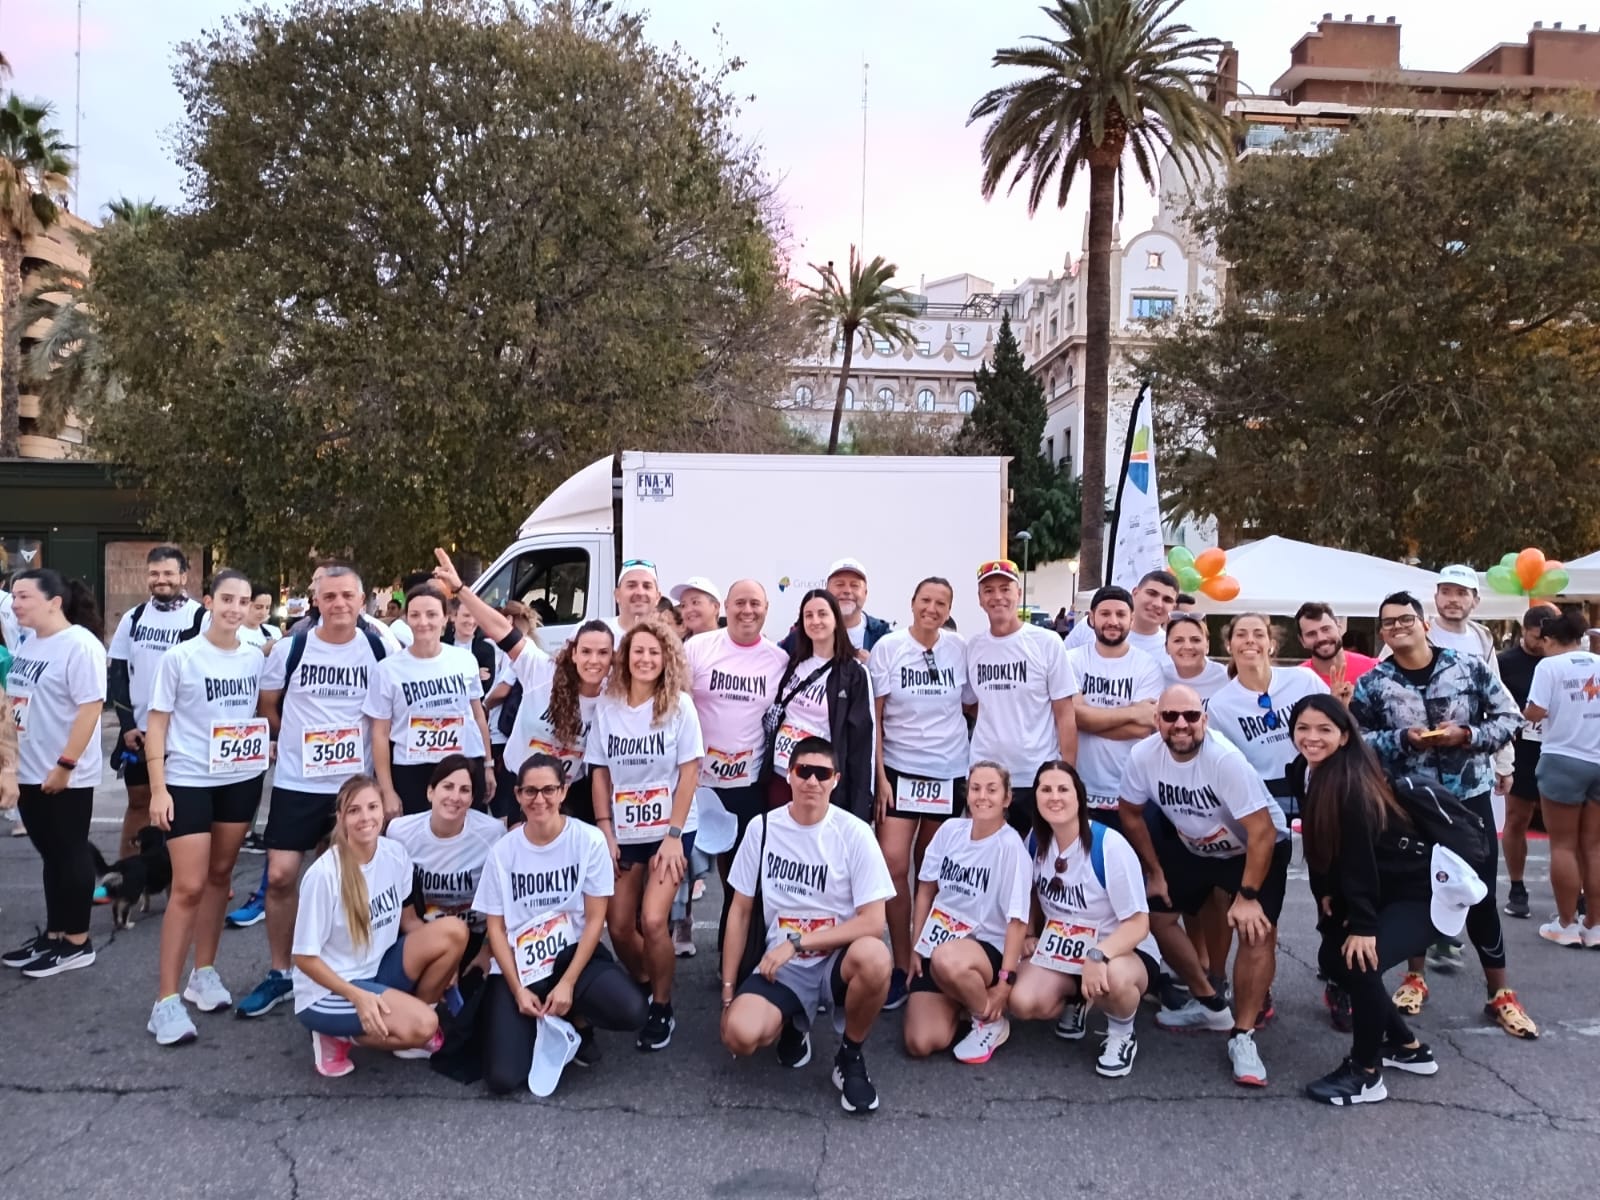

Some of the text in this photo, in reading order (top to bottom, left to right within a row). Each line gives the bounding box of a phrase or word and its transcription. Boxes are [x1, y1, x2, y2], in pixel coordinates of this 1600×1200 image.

[638, 475, 671, 488] FNA-X
[300, 664, 368, 690] BROOKLYN
[709, 669, 767, 697] BROOKLYN
[901, 667, 956, 688] BROOLYN
[978, 660, 1027, 686] BROOKLYN
[401, 673, 467, 706] BROOKLYN
[220, 738, 262, 758] 5498
[312, 741, 356, 762] 3508
[415, 730, 459, 748] 3304
[607, 731, 665, 758] BROOKLYN
[710, 759, 748, 777] 4000
[910, 780, 942, 800] 1819
[625, 803, 663, 823] 5169
[511, 863, 580, 902] BROOKLYN
[767, 852, 828, 893] BROOKLYN
[940, 855, 991, 893] BROOKLYN
[524, 930, 568, 966] 3804
[1045, 933, 1085, 959] 5168
